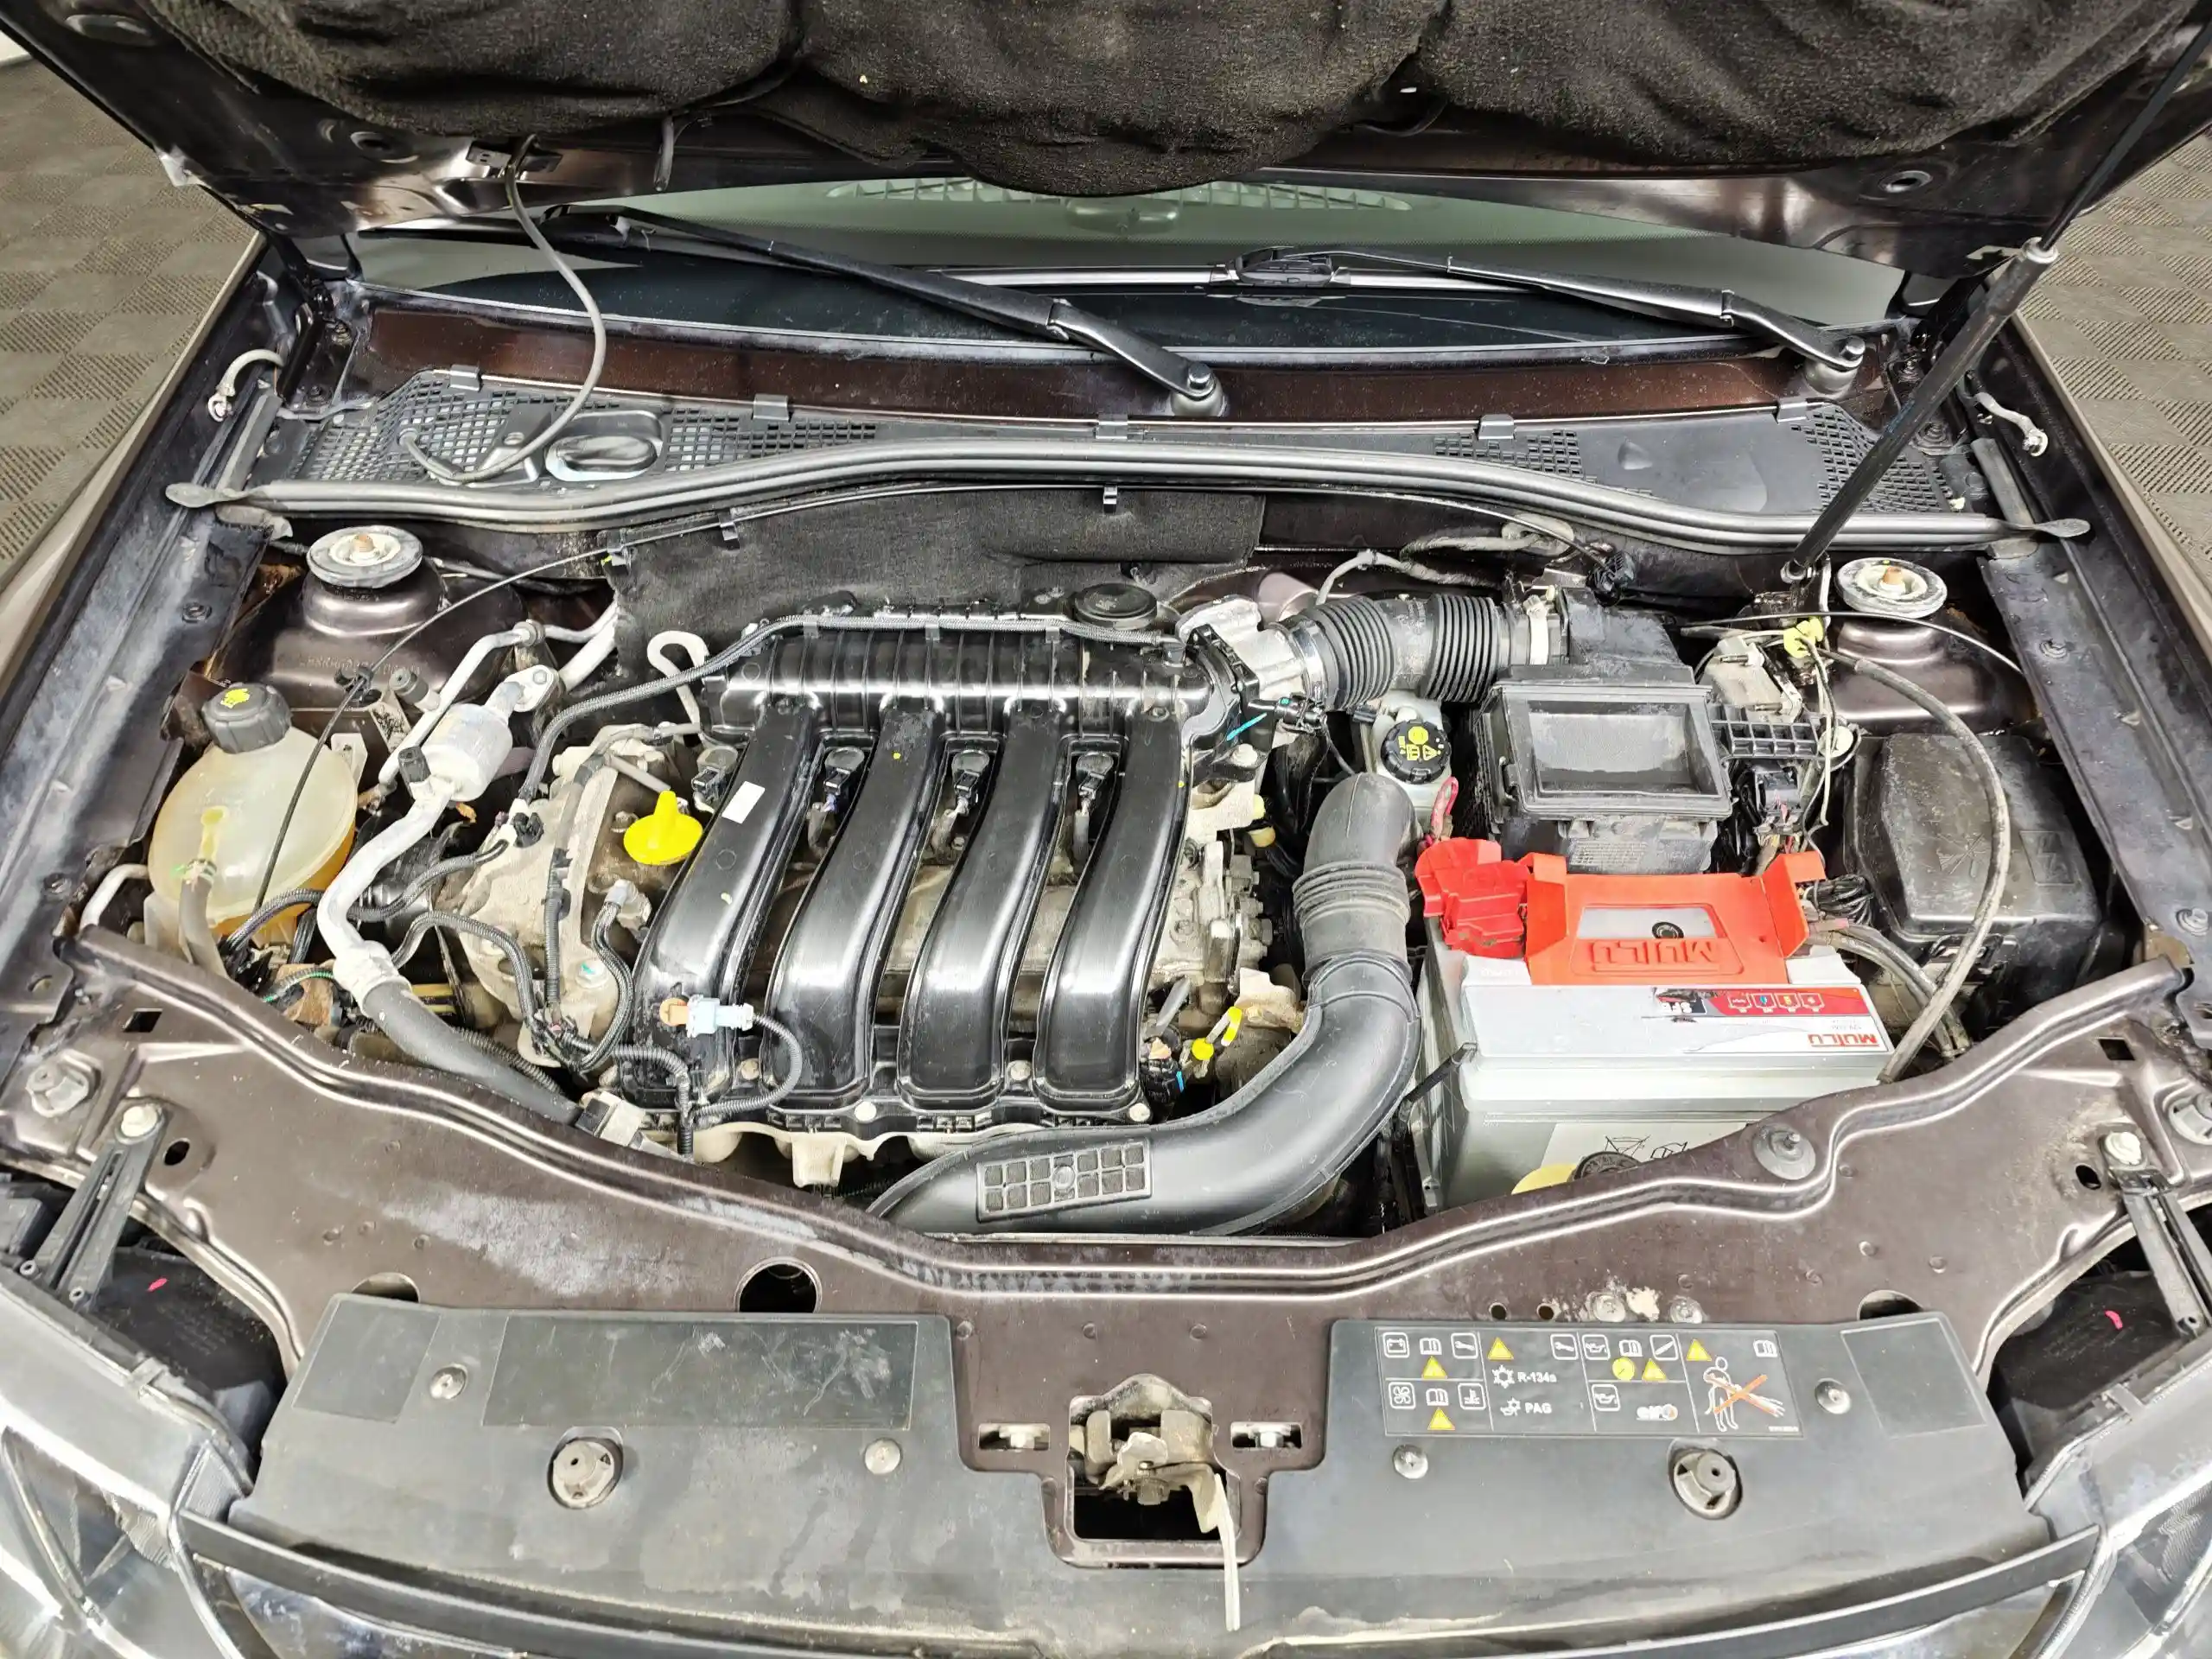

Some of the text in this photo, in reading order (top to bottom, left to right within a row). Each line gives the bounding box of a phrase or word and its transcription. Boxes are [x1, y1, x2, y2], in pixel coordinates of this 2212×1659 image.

[1807, 1033, 1880, 1047] MUTLU
[1516, 1371, 1558, 1383] R-134a
[1524, 1402, 1553, 1414] PAG
